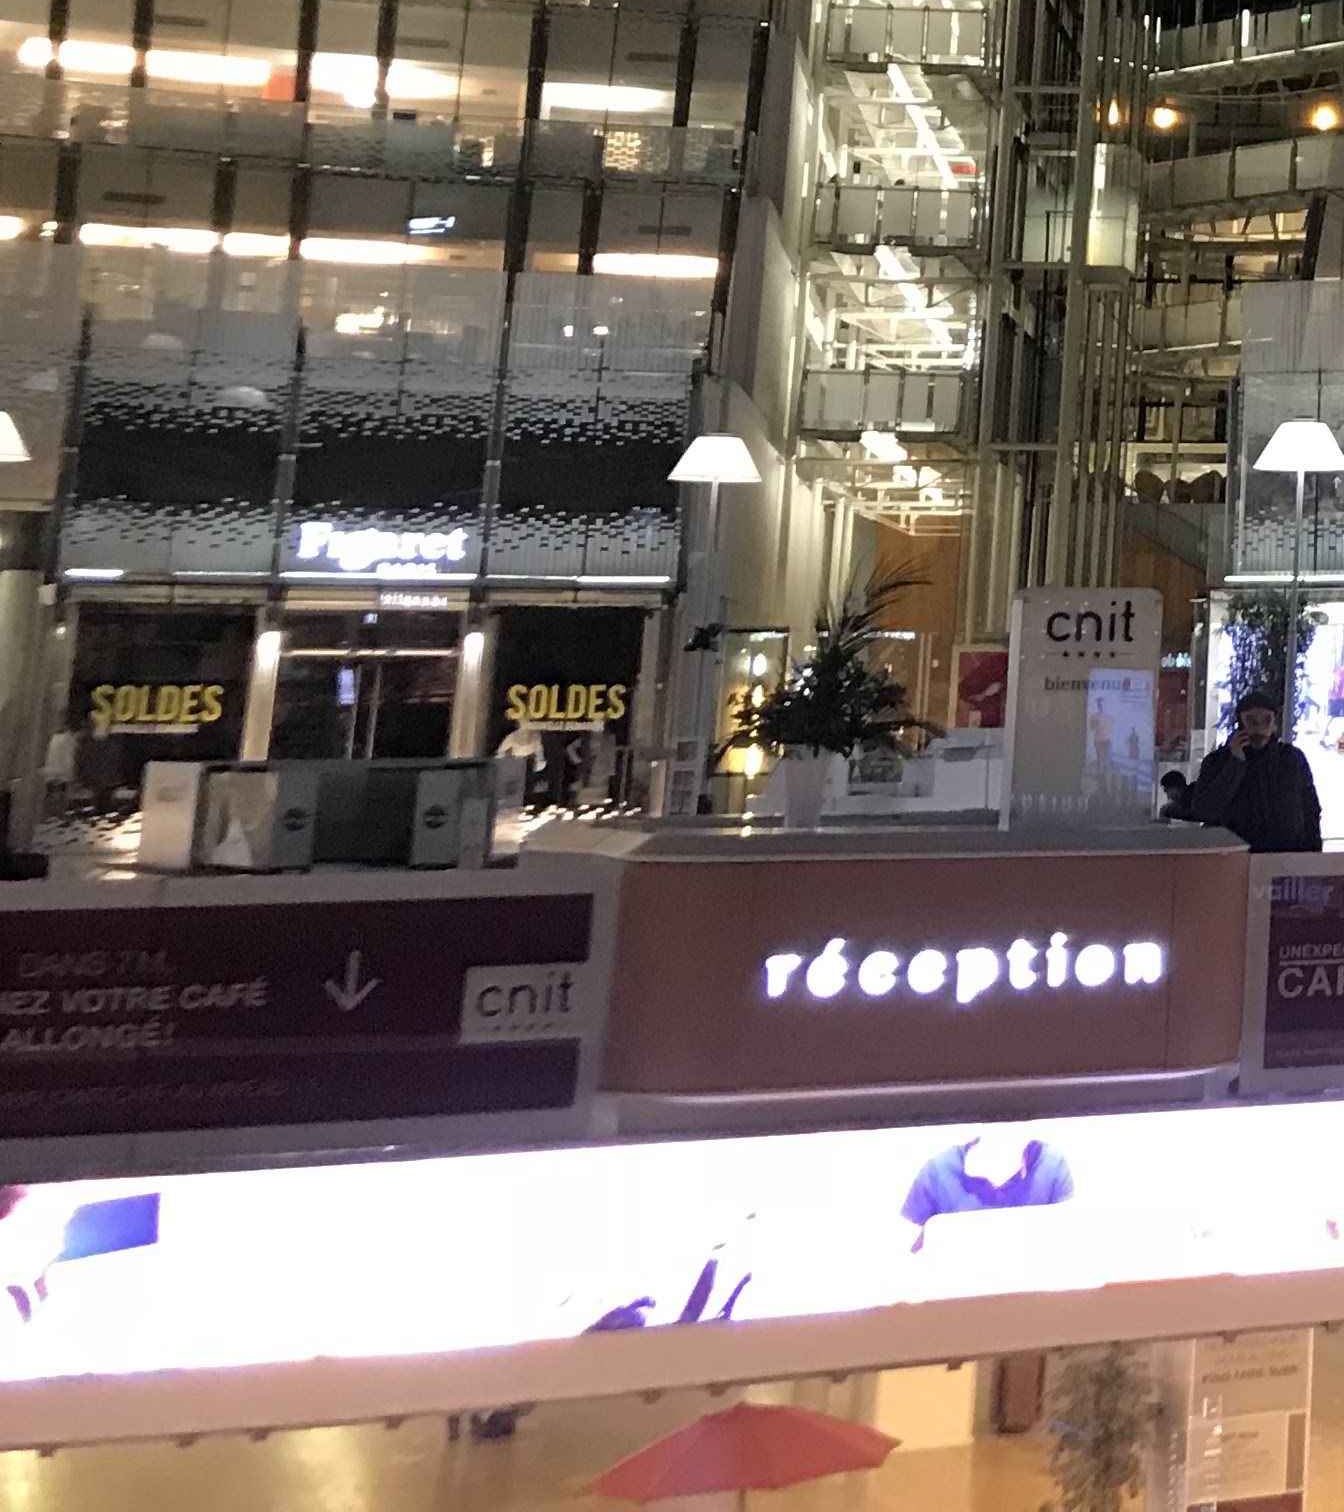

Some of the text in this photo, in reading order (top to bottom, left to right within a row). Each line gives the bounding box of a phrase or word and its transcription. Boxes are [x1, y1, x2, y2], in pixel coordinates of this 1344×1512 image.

[1046, 600, 1136, 642] cnit
[90, 684, 224, 725] SOLDES
[506, 684, 626, 721] SOLDES
[764, 931, 1162, 1005] réception
[62, 985, 174, 1015] VOTRE
[178, 974, 269, 1011] CAFÉ
[476, 970, 575, 1018] cnit
